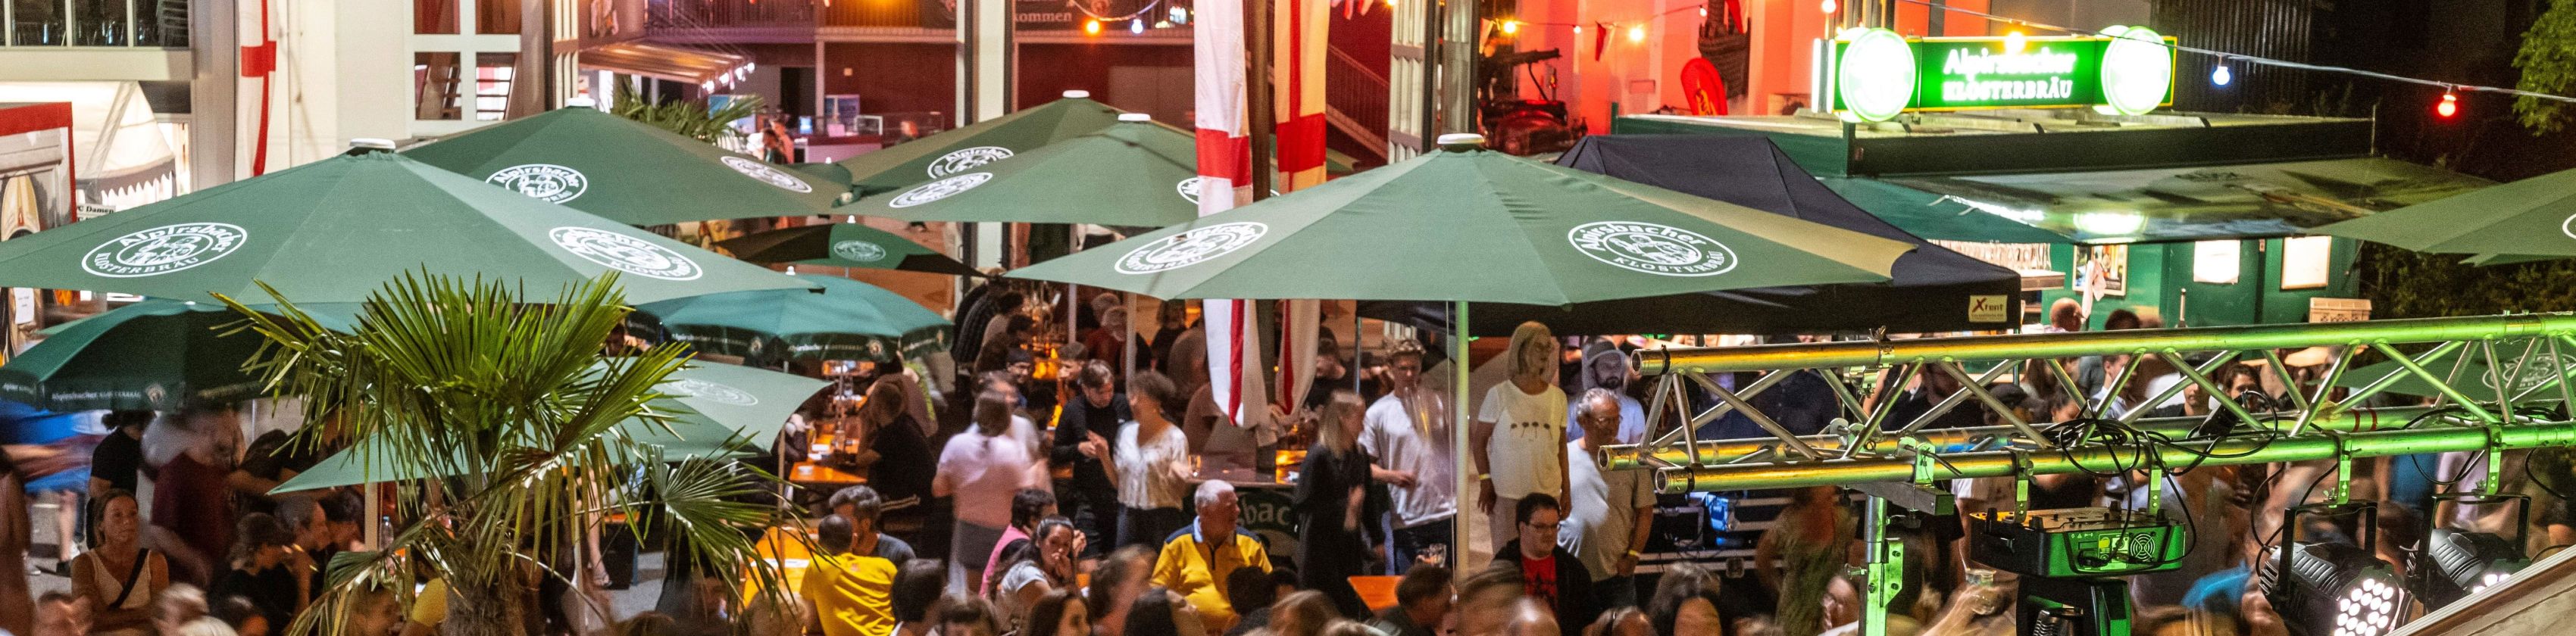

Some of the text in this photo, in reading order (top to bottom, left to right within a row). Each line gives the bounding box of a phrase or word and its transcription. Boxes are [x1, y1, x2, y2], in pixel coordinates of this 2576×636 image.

[1943, 76, 2073, 101] KLOSTERBRÄU
[86, 205, 114, 214] Damen
[120, 224, 242, 253] Alpirsbacher
[1575, 223, 1706, 251] Alpirsbacher
[95, 252, 199, 273] KLOSTERBRÄU
[1614, 251, 1725, 273] KLOSTERBRÄU
